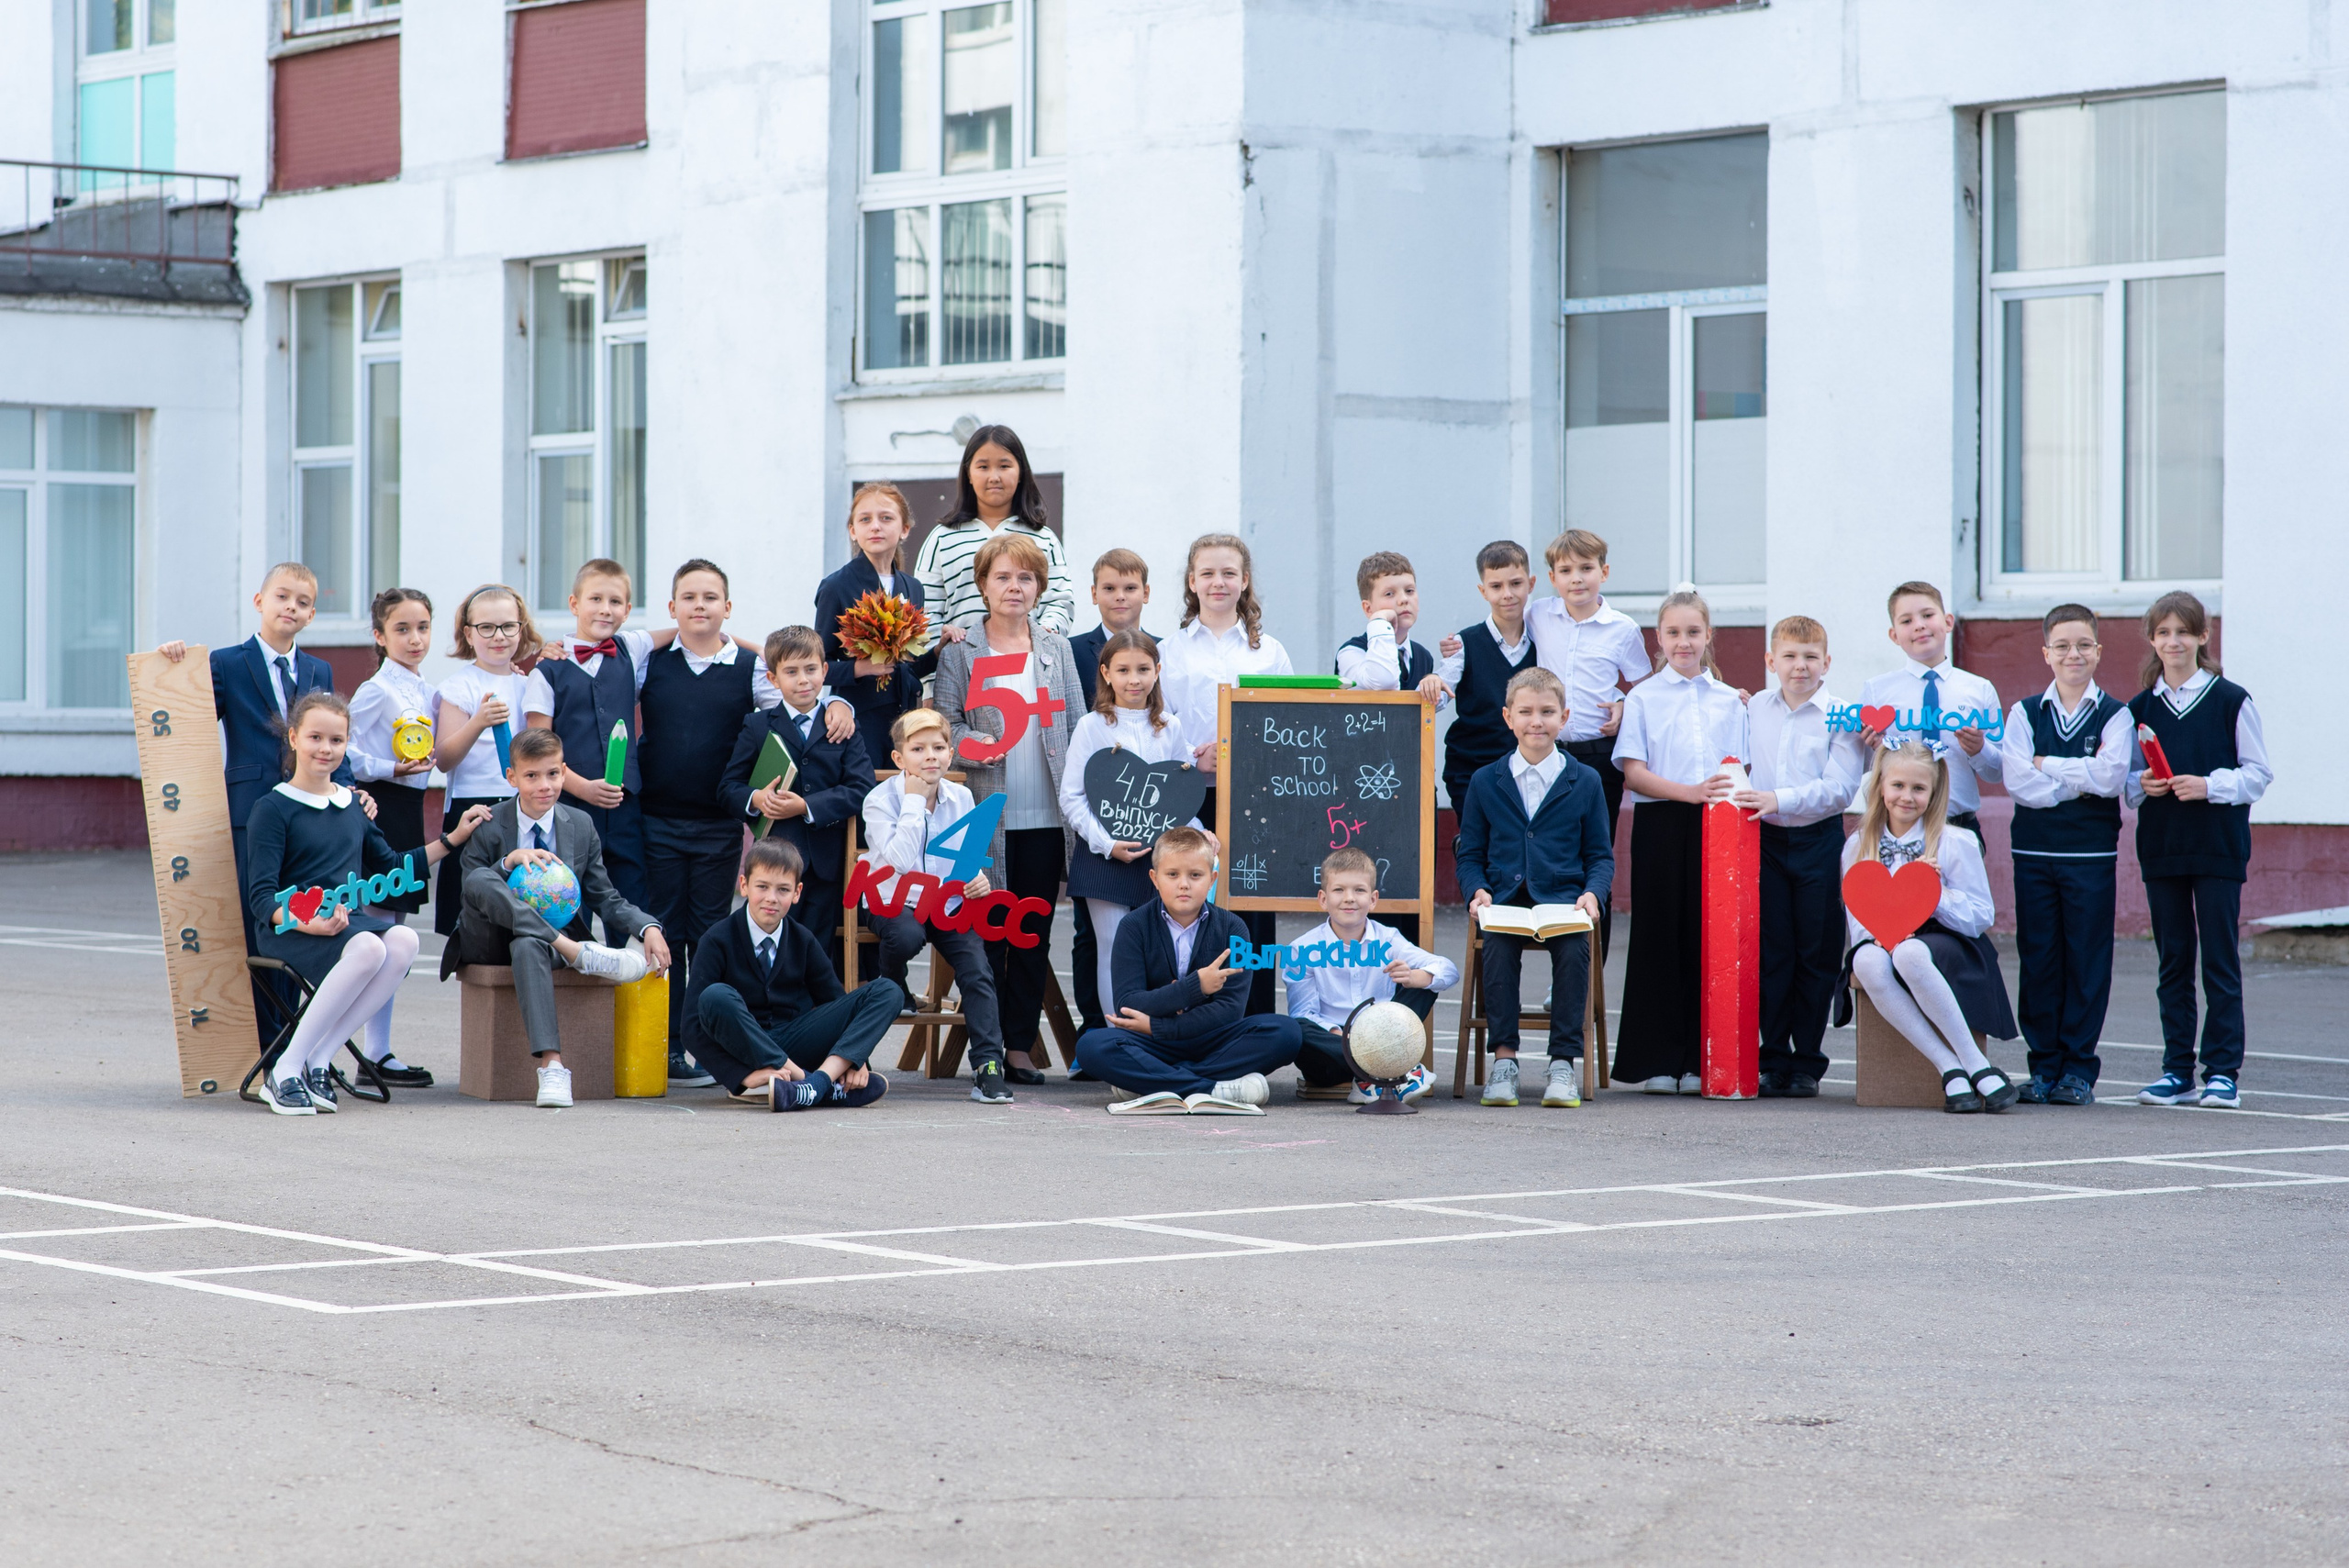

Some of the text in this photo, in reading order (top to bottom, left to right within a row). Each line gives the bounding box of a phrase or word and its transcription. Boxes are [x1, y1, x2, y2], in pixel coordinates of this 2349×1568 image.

[958, 652, 1065, 762] 5+
[151, 710, 172, 737] 50
[1264, 717, 1327, 748] Back
[1344, 710, 1386, 736] 2+2=4
[162, 783, 181, 812] 40
[1111, 821, 1154, 843] 2024
[1327, 803, 1367, 849] 5+
[171, 856, 190, 883] 30
[180, 928, 200, 953] 20
